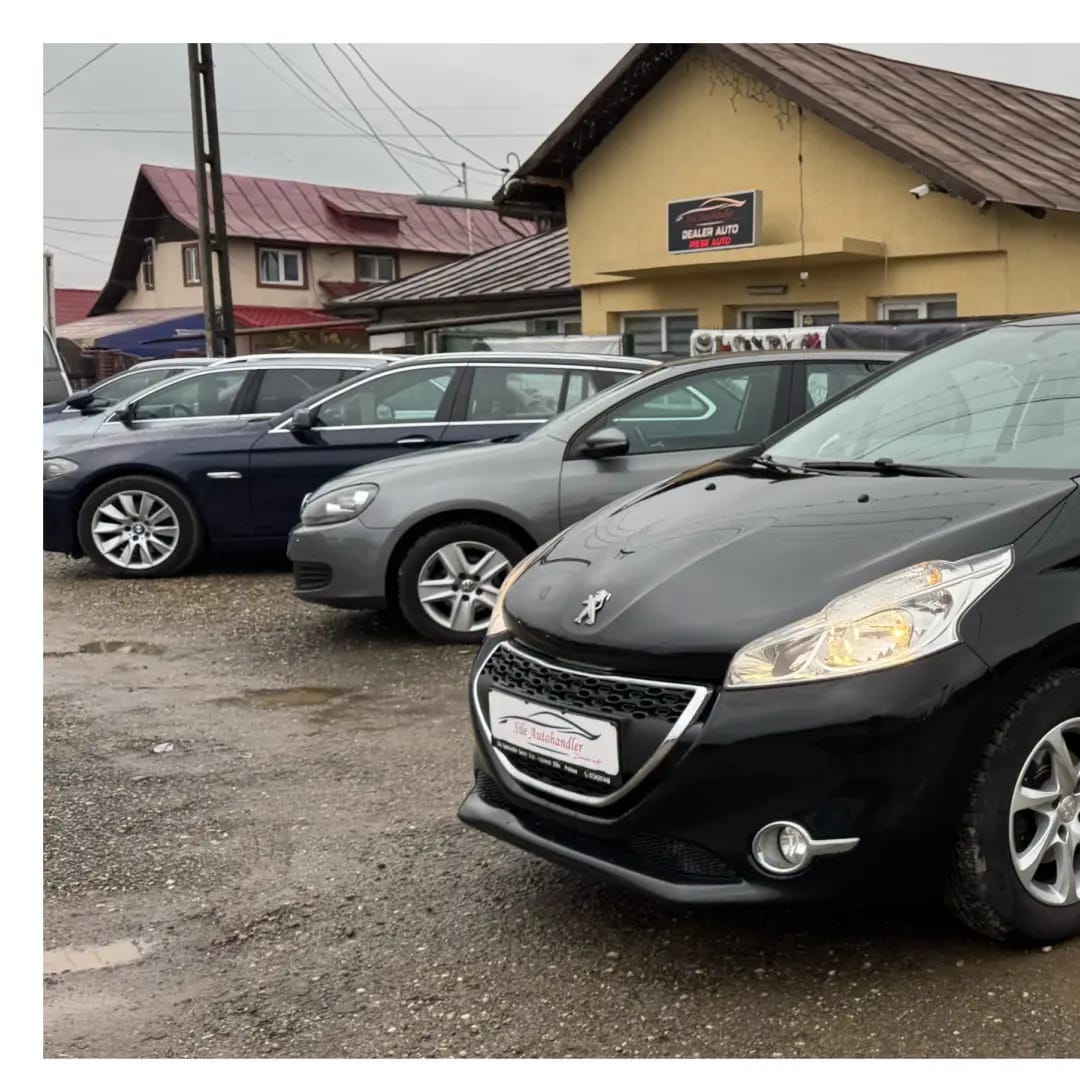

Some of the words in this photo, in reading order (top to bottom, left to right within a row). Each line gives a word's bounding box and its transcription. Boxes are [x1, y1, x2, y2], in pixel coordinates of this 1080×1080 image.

[682, 227, 714, 240] DEALER
[715, 224, 739, 236] AUTO
[513, 721, 528, 736] Sile
[528, 727, 584, 753] Autohandler
